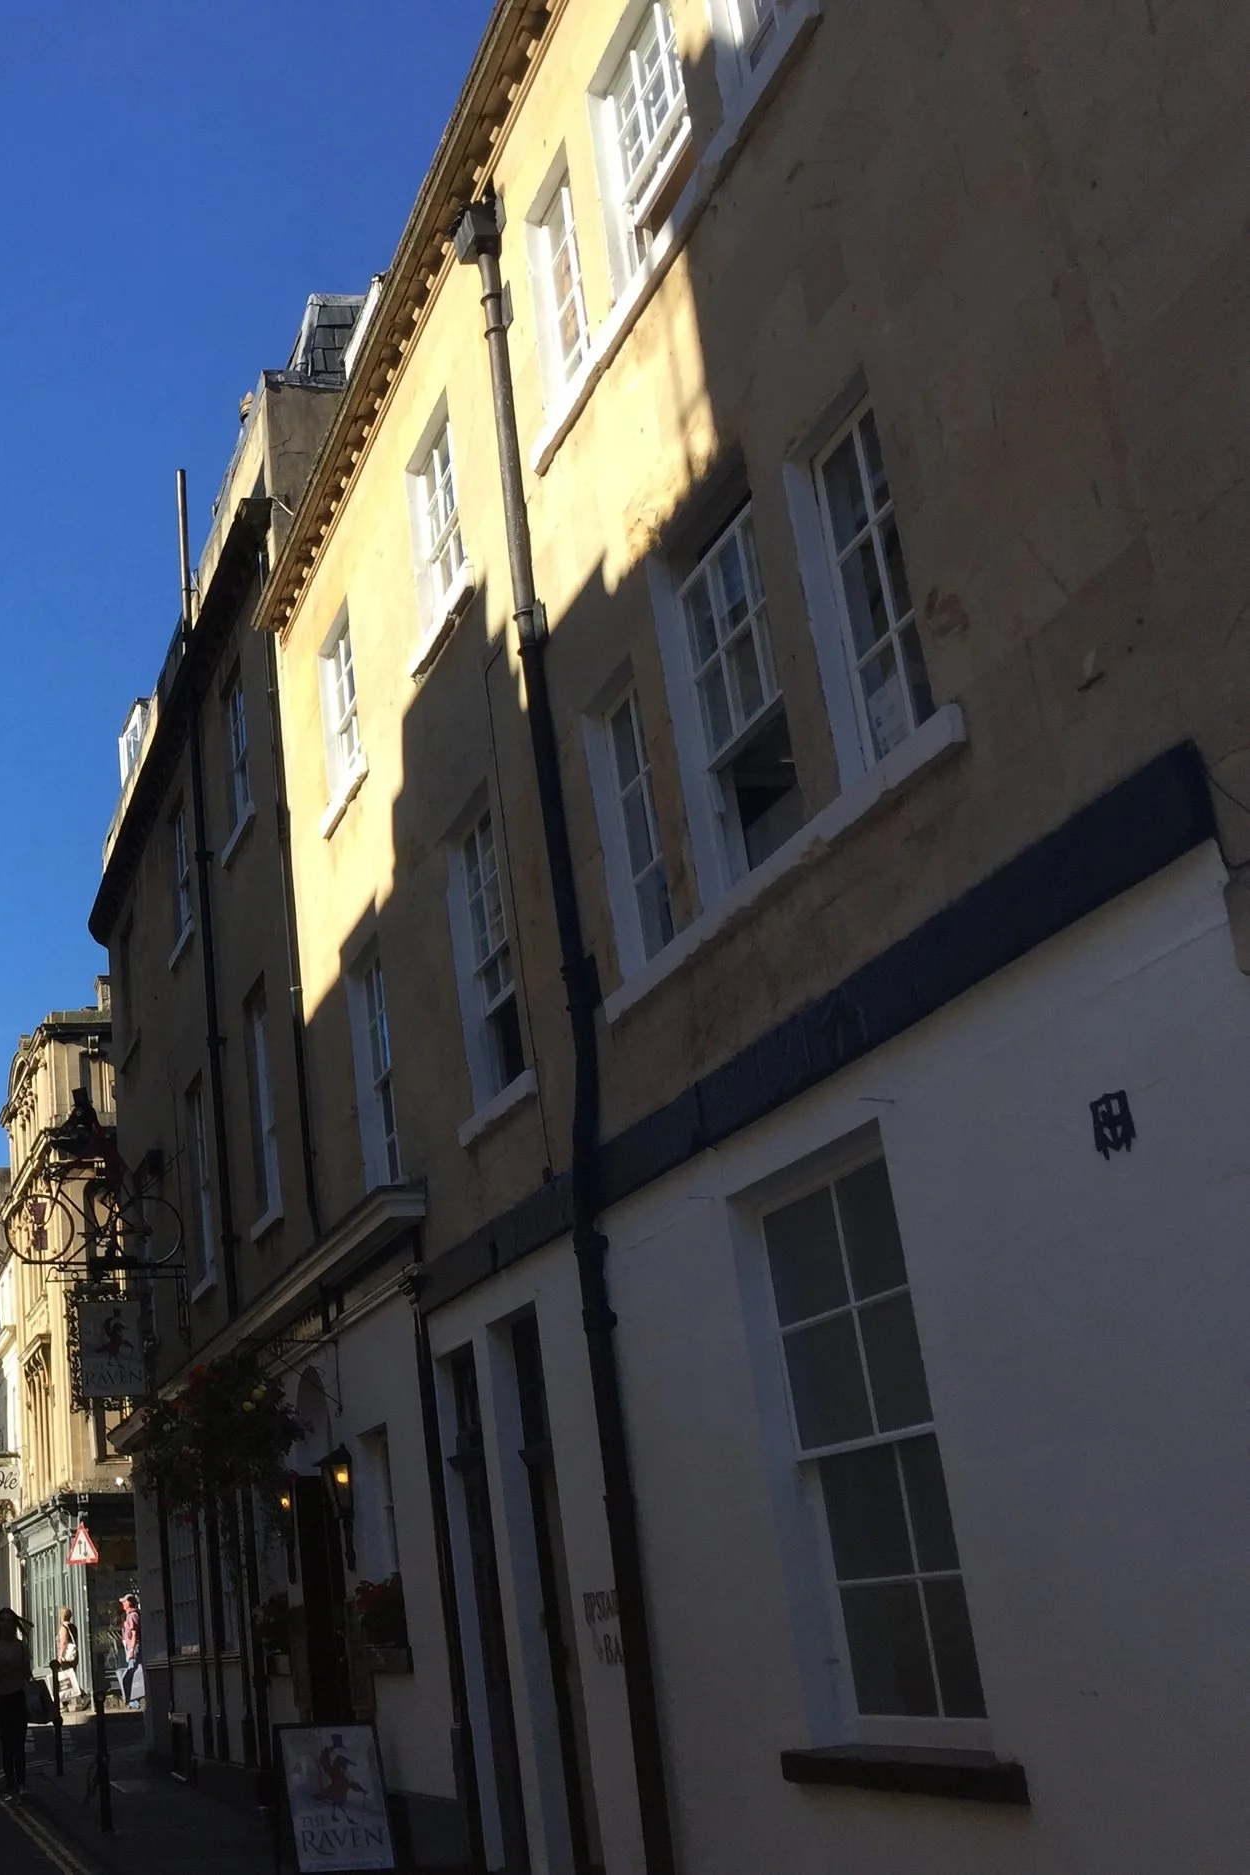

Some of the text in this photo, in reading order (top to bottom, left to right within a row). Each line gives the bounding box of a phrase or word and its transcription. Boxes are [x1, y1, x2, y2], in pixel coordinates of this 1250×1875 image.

[85, 1369, 142, 1390] RAVEN
[299, 1815, 326, 1827] THE
[302, 1827, 384, 1856] RAVEN
